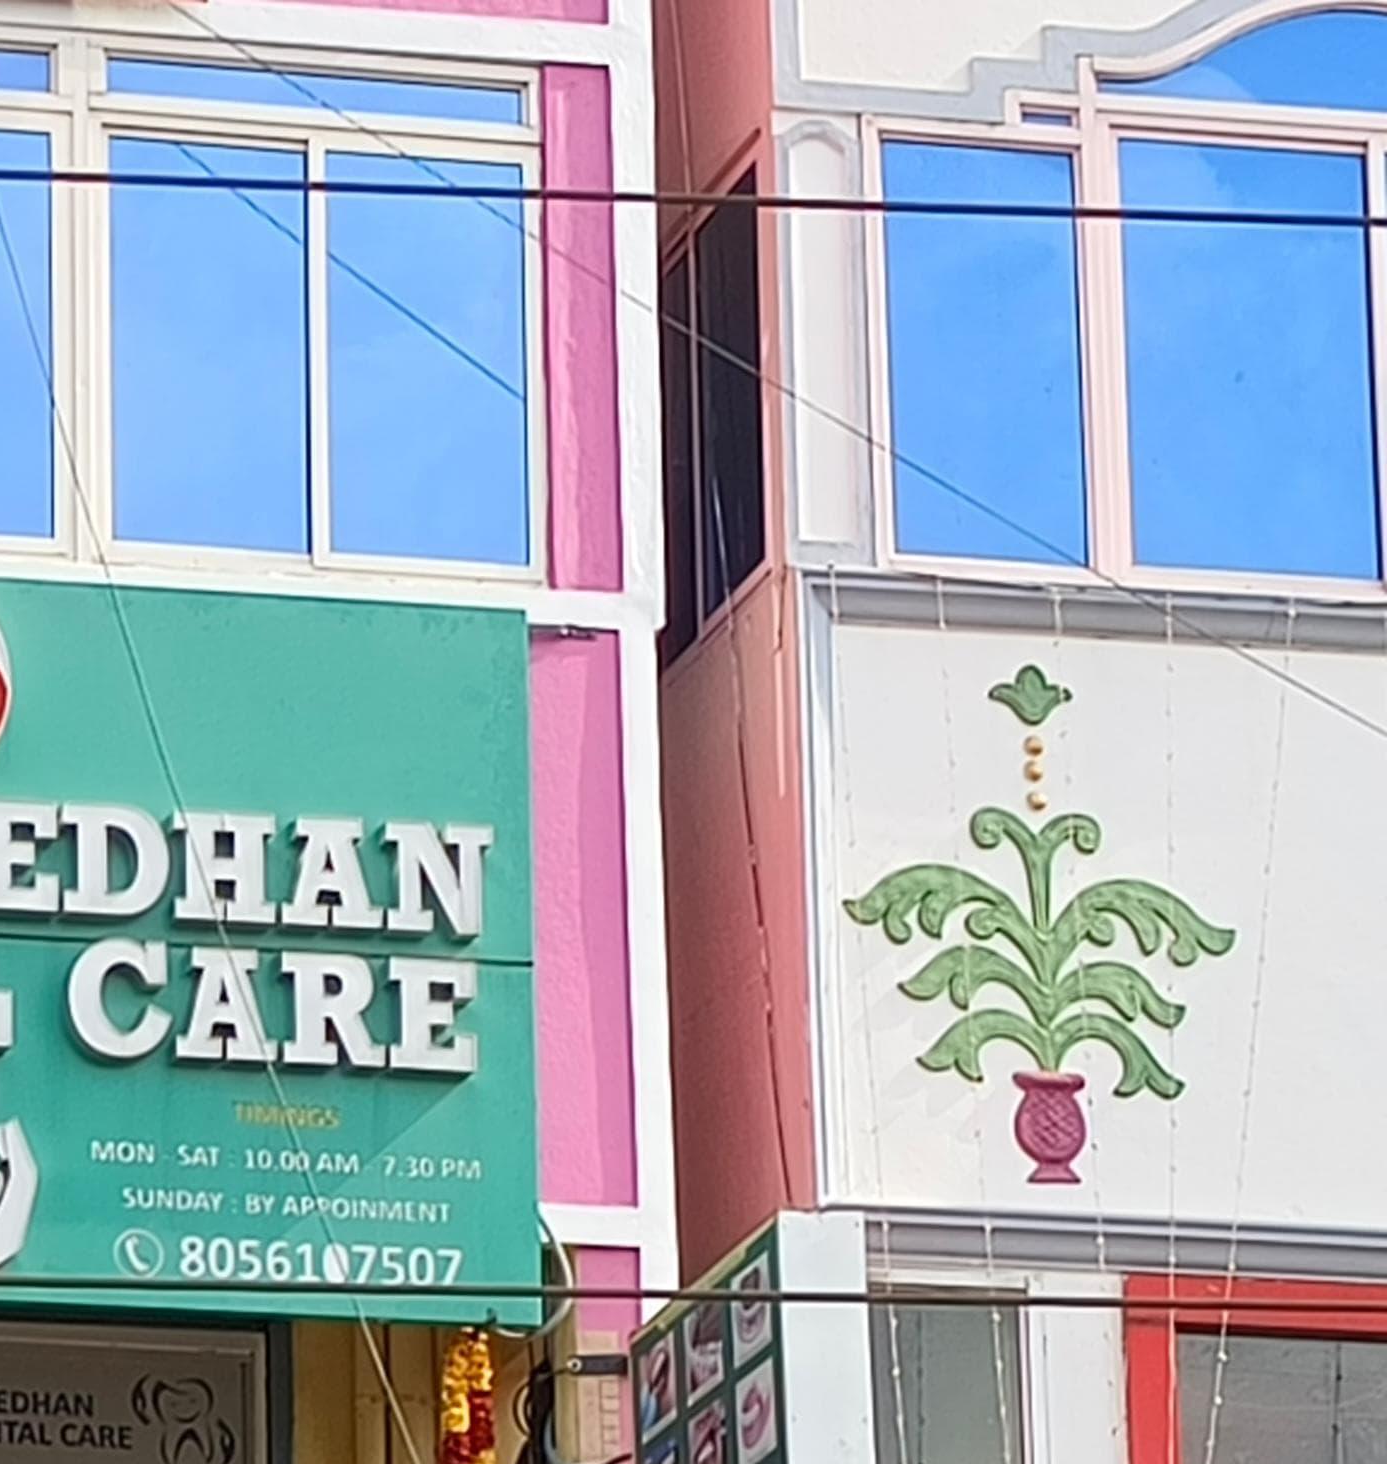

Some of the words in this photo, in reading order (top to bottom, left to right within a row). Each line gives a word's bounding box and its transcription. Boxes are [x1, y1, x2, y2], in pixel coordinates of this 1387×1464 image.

[67, 938, 479, 1078] CARE
[90, 1140, 155, 1165] MON
[177, 1145, 220, 1167] SAT
[244, 1148, 311, 1173] 10.00
[316, 1153, 360, 1175] AM
[383, 1156, 435, 1178] 7.30
[441, 1158, 482, 1181] PM
[122, 1187, 225, 1213] SUNDAY
[245, 1195, 276, 1215] BY
[179, 1236, 463, 1287] 8056107507
[60, 1422, 133, 1450] CARE
